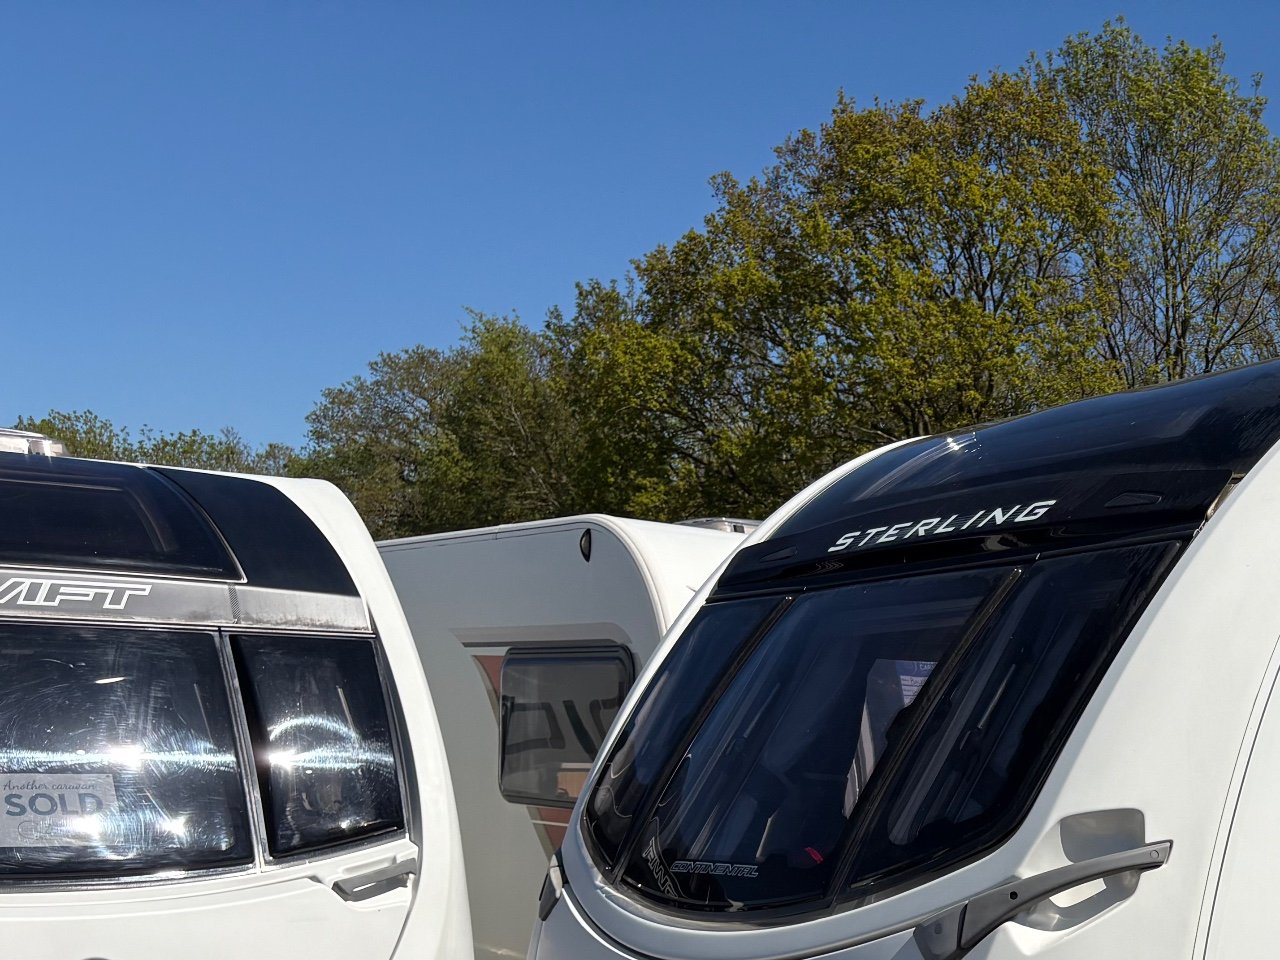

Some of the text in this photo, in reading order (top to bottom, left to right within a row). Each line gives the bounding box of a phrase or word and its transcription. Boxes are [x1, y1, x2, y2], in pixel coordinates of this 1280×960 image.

[827, 500, 1057, 552] STERLING
[3, 780, 98, 791] Another caravan
[4, 793, 104, 816] SOLD
[670, 860, 759, 878] CONTINENTAL
